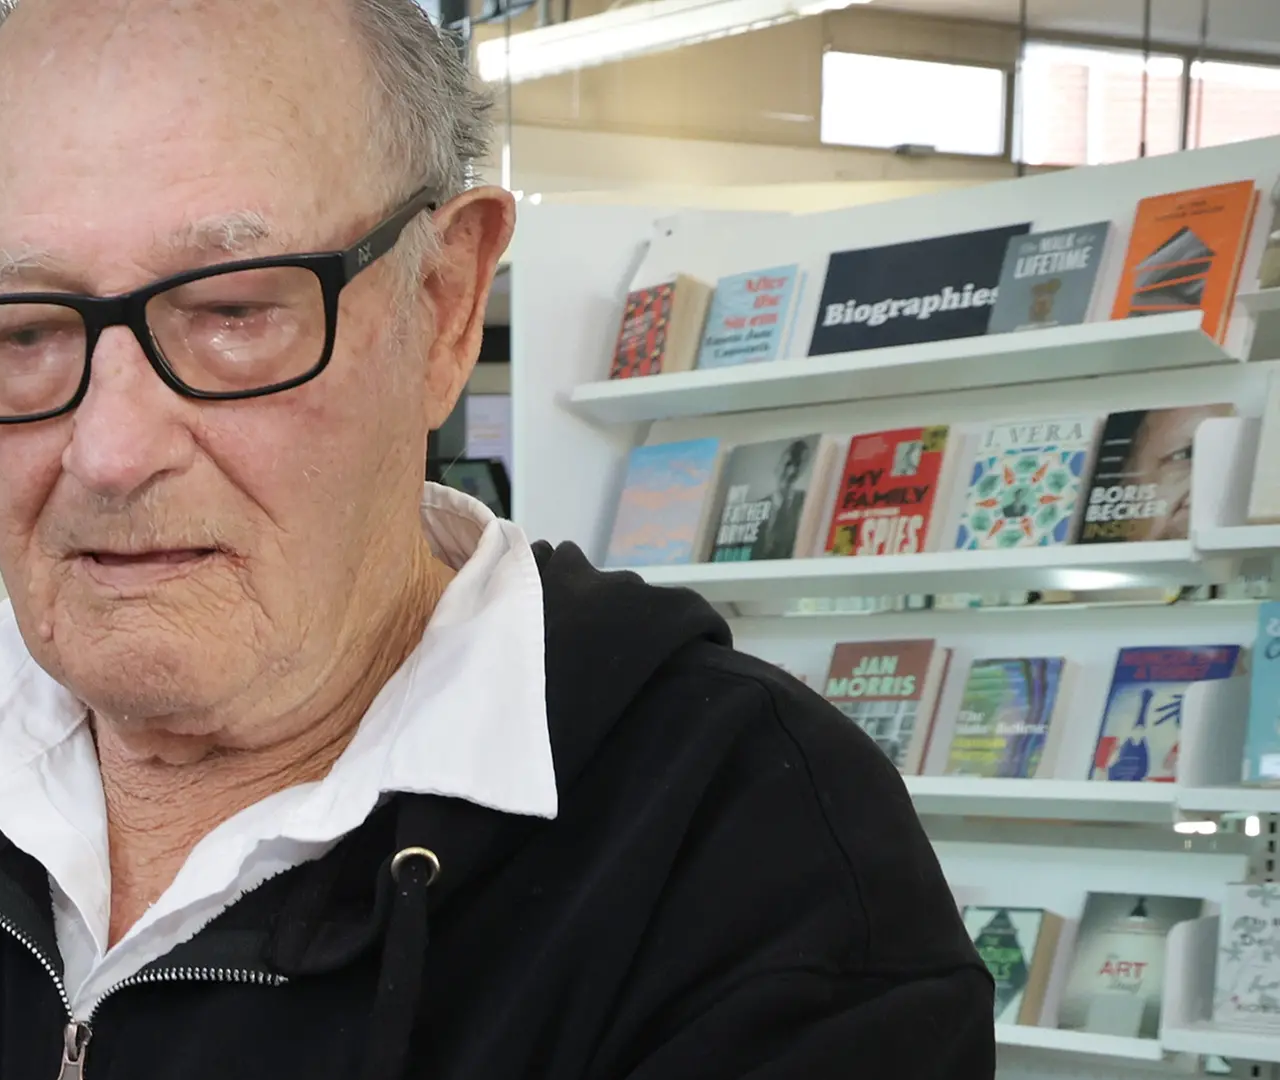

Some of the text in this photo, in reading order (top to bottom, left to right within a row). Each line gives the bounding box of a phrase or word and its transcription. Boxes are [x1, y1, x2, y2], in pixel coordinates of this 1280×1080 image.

[1013, 246, 1094, 279] LIFETIME
[822, 283, 1000, 327] Biographies
[848, 468, 883, 487] MY
[842, 486, 930, 508] FAMILY
[1090, 485, 1157, 504] BORIS
[1086, 502, 1168, 521] BECKER
[852, 655, 898, 676] JAN
[826, 675, 916, 697] MORRIS
[1098, 961, 1148, 980] ART
